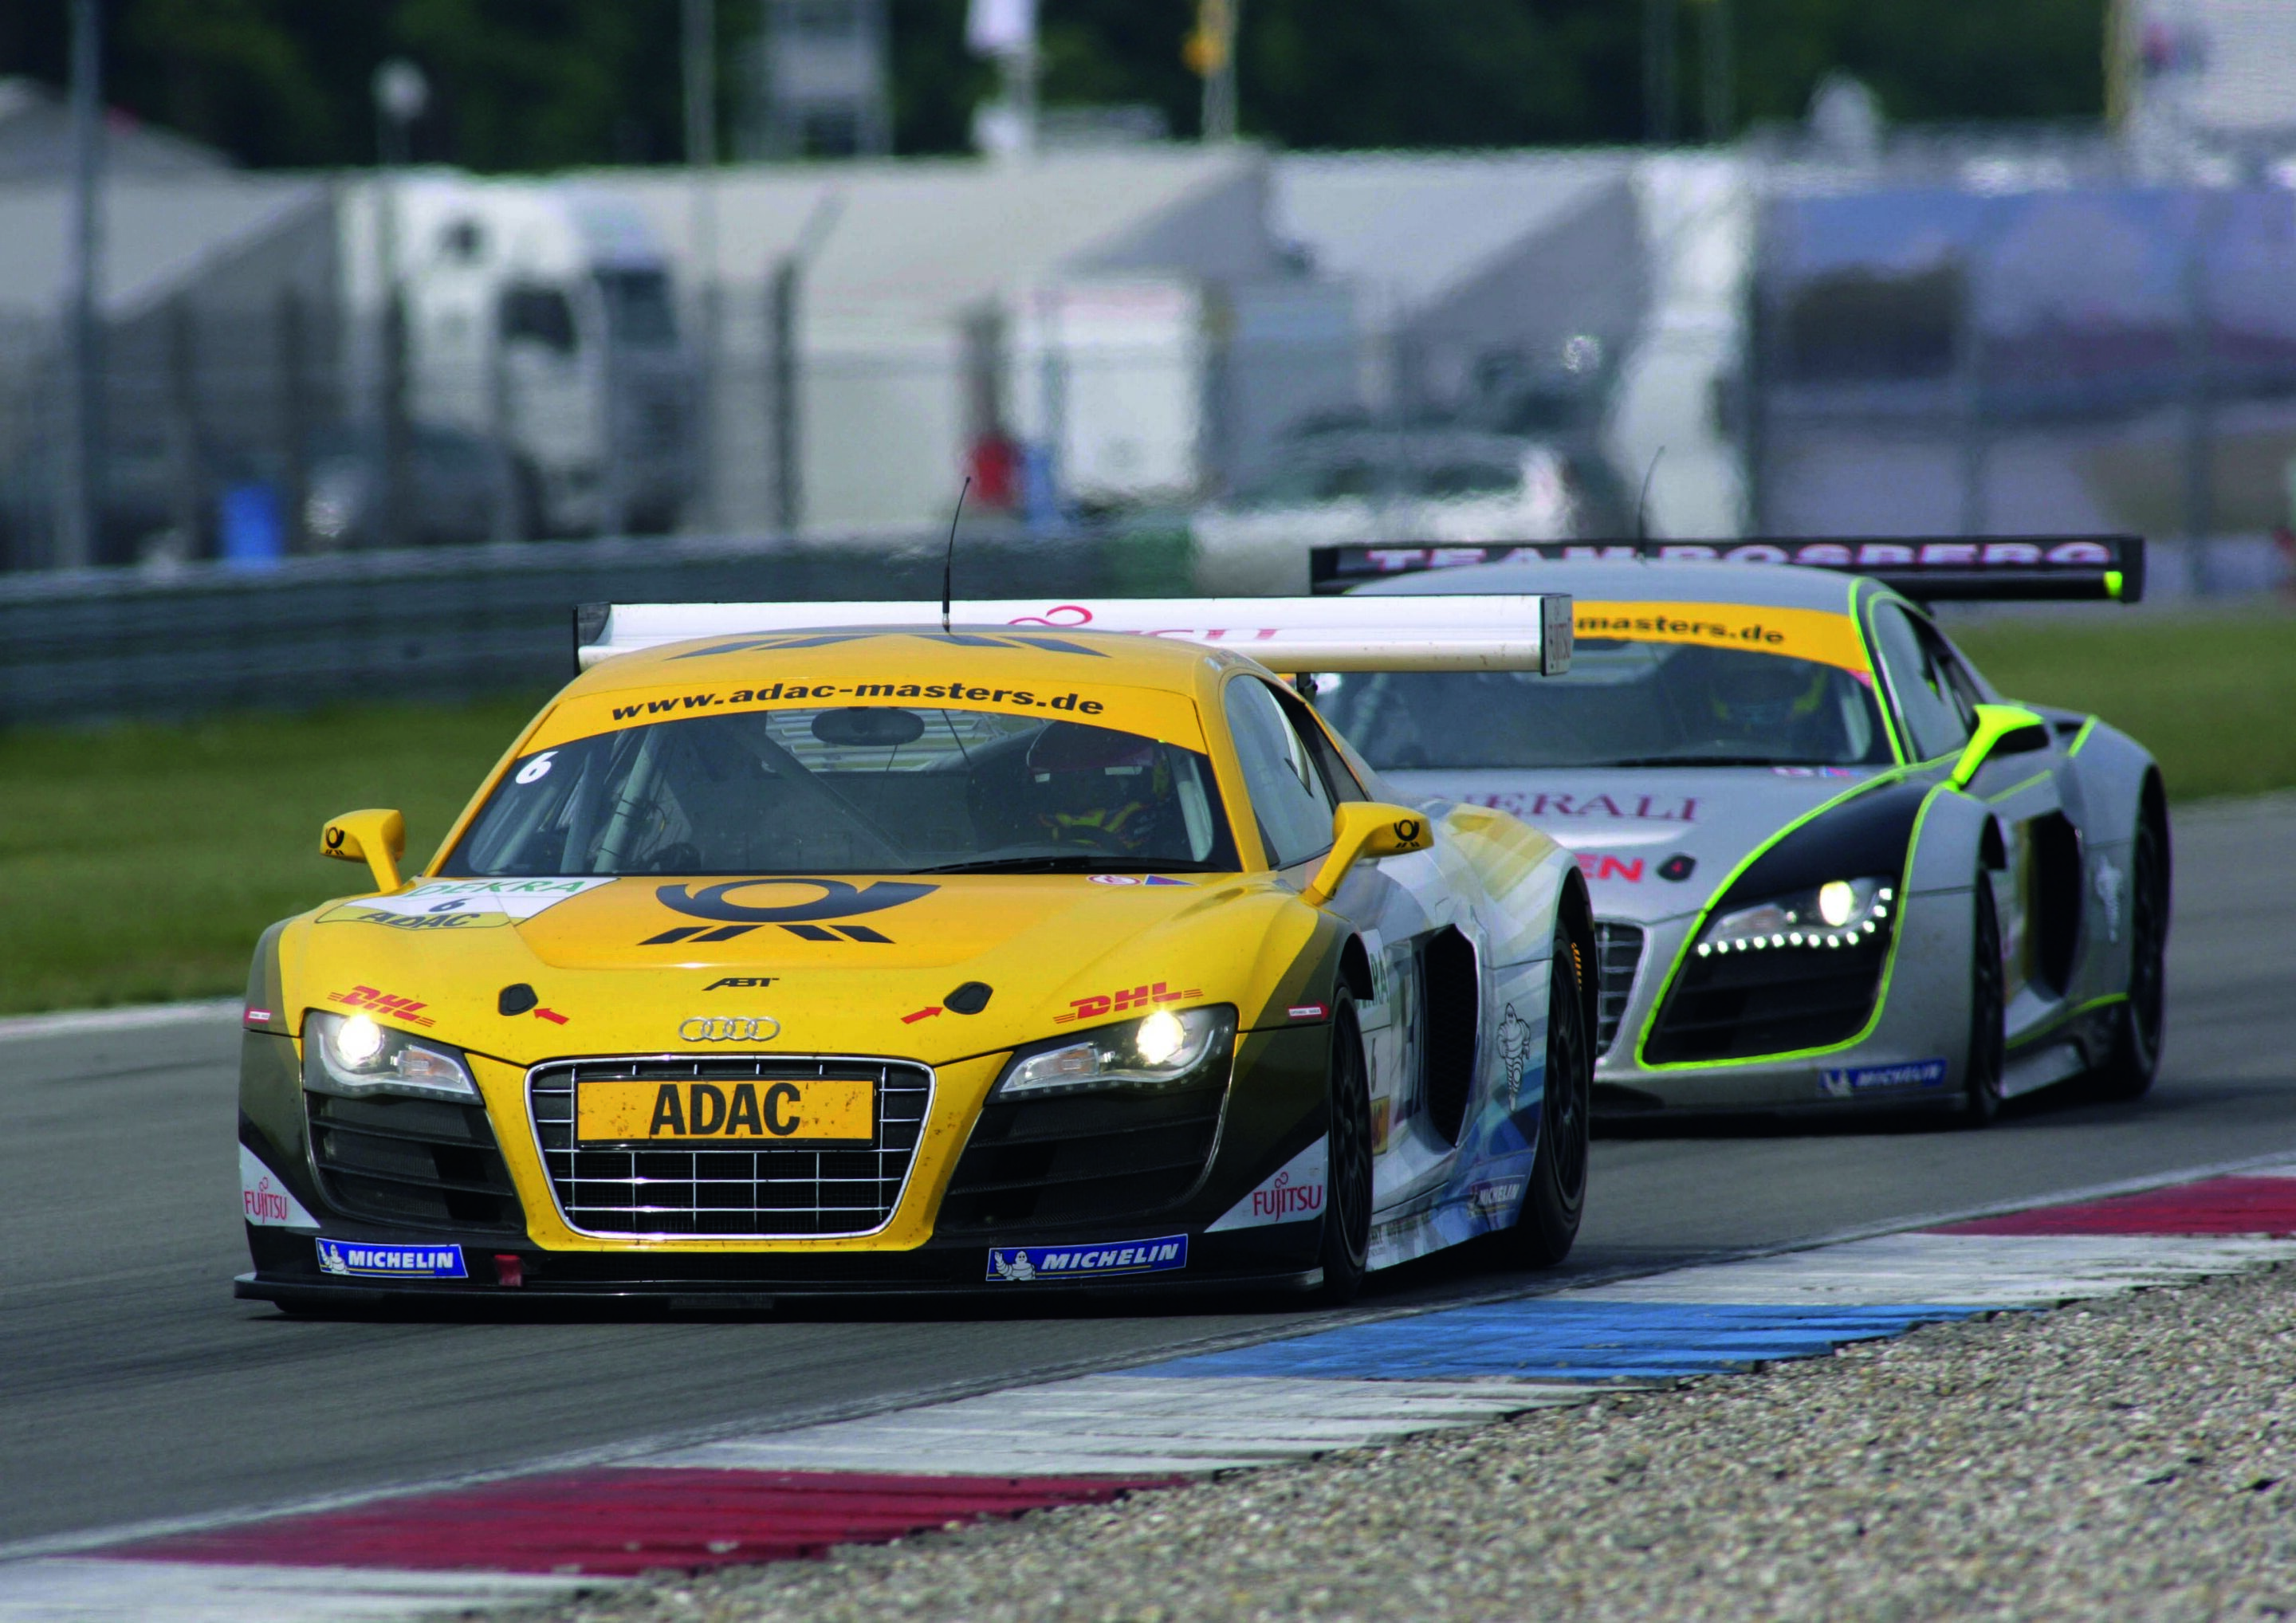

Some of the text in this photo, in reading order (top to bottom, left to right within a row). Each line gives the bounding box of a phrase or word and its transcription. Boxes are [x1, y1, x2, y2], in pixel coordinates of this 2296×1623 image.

[1658, 542, 2109, 564] ROSBERG
[611, 682, 1104, 721] www.adac-masters.de
[515, 751, 559, 784] 6
[408, 879, 584, 896] DEKRA
[357, 911, 482, 928] ADAC
[428, 898, 472, 913] 6
[702, 977, 773, 991] ABT
[336, 985, 427, 1022] DHL
[1070, 982, 1181, 1019] DHL
[649, 1082, 802, 1137] ADAC
[1252, 1184, 1323, 1223] FUJITSU
[348, 1249, 454, 1269] MICHELIN
[1040, 1243, 1180, 1271] MICHELIN
